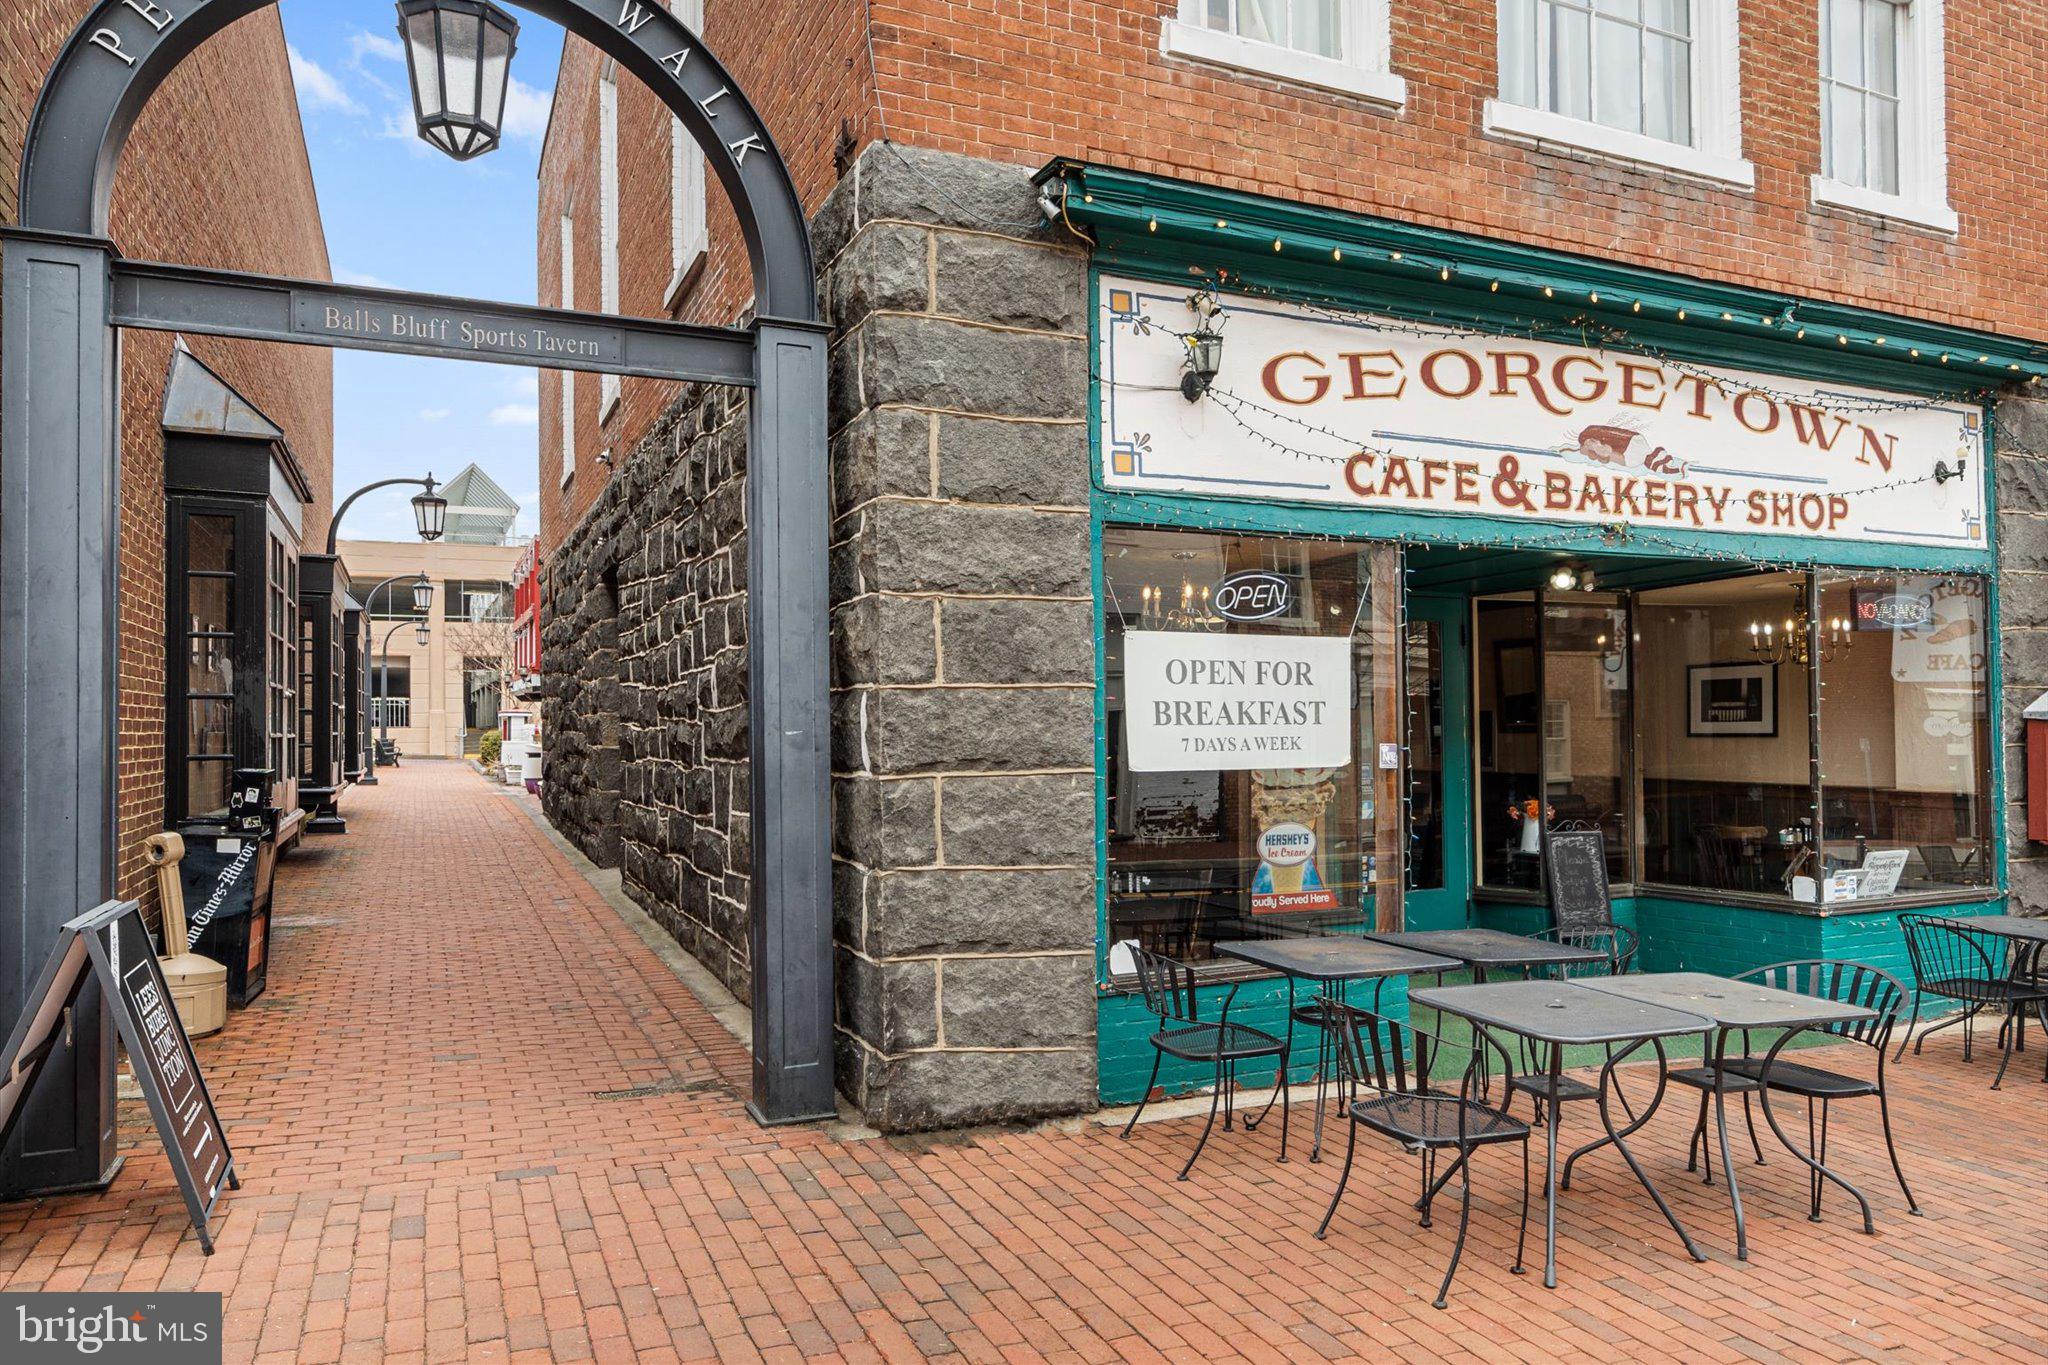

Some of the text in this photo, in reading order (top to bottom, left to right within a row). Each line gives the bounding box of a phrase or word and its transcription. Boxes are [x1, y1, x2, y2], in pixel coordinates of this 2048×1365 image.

[617, 0, 767, 168] WALK
[325, 306, 600, 356] Balls Bluff Sports Tavern
[1260, 348, 1900, 473] GEORGETOWN
[1344, 452, 1850, 531] CAFE & BAKERY SHOP
[1215, 583, 1288, 610] OPEN
[1857, 602, 1876, 619] NO
[1165, 658, 1313, 686] OPEN FOR
[1153, 700, 1326, 726] BREAKFAST
[1181, 736, 1302, 752] 7 DAYS A WEEK
[1268, 847, 1307, 858] Ice Cream
[191, 842, 257, 926] Times-Mirror
[1278, 894, 1309, 906] Served
[1310, 893, 1330, 903] Here
[135, 981, 159, 1016] LEES
[145, 1005, 168, 1039] BURG
[154, 1027, 176, 1063] JUNC
[162, 1048, 185, 1087] TION
